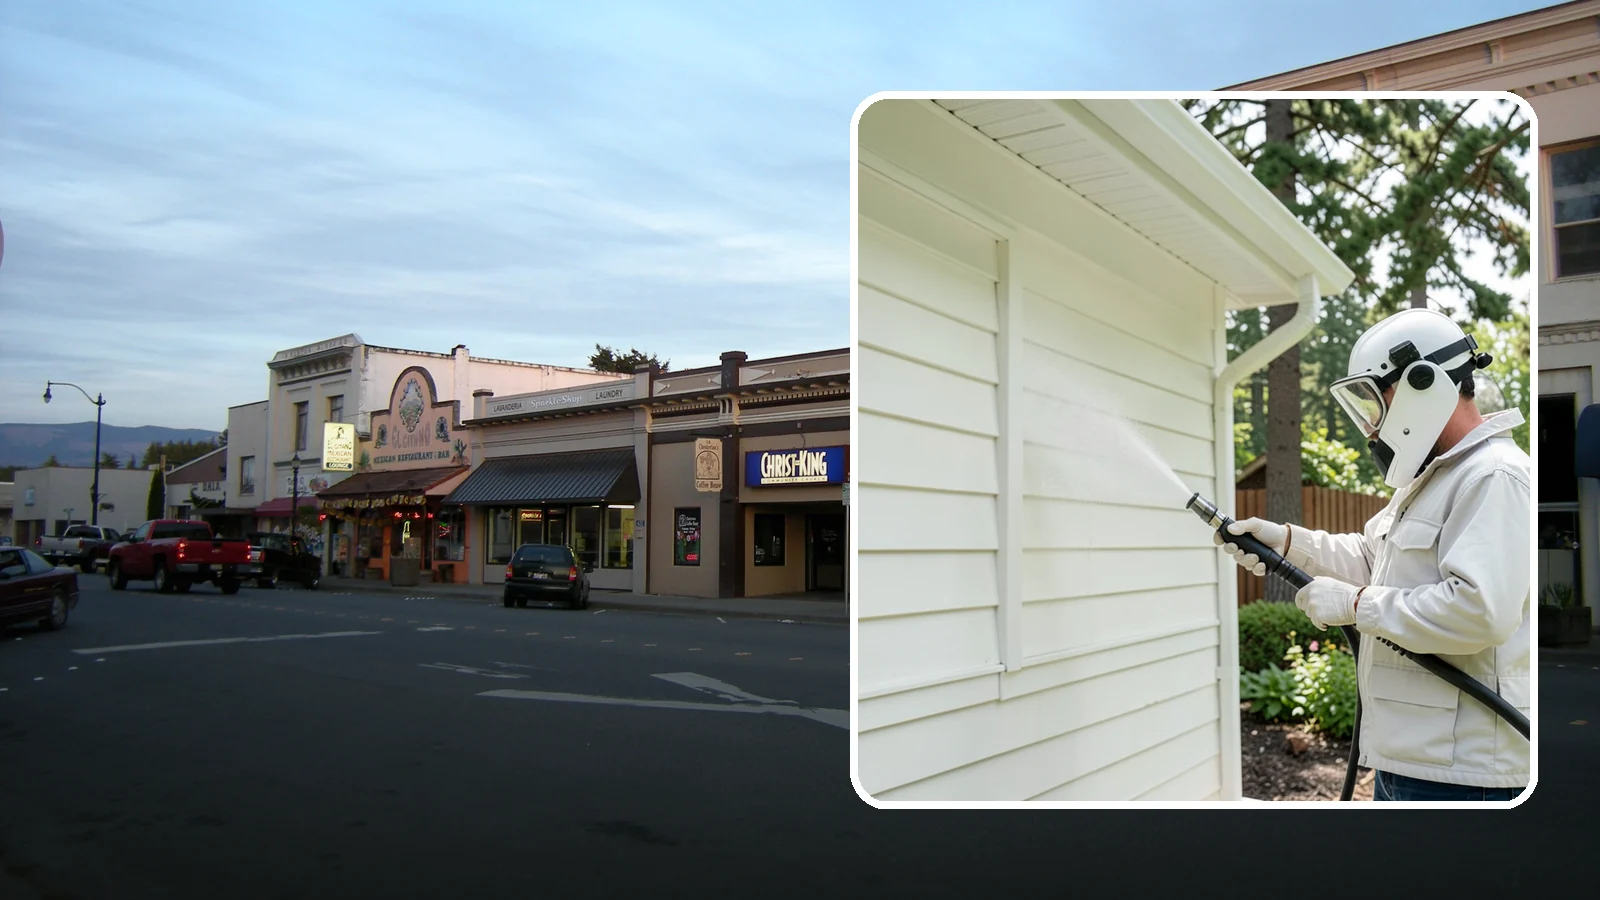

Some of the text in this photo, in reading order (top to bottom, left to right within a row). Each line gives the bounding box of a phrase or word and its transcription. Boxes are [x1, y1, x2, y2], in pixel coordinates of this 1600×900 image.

[494, 402, 522, 412] LAVANDERIA
[595, 389, 623, 399] LAUNDRY
[397, 451, 433, 462] RESTAURANT
[438, 450, 450, 459] BAR
[761, 450, 827, 478] CHRIST KING
